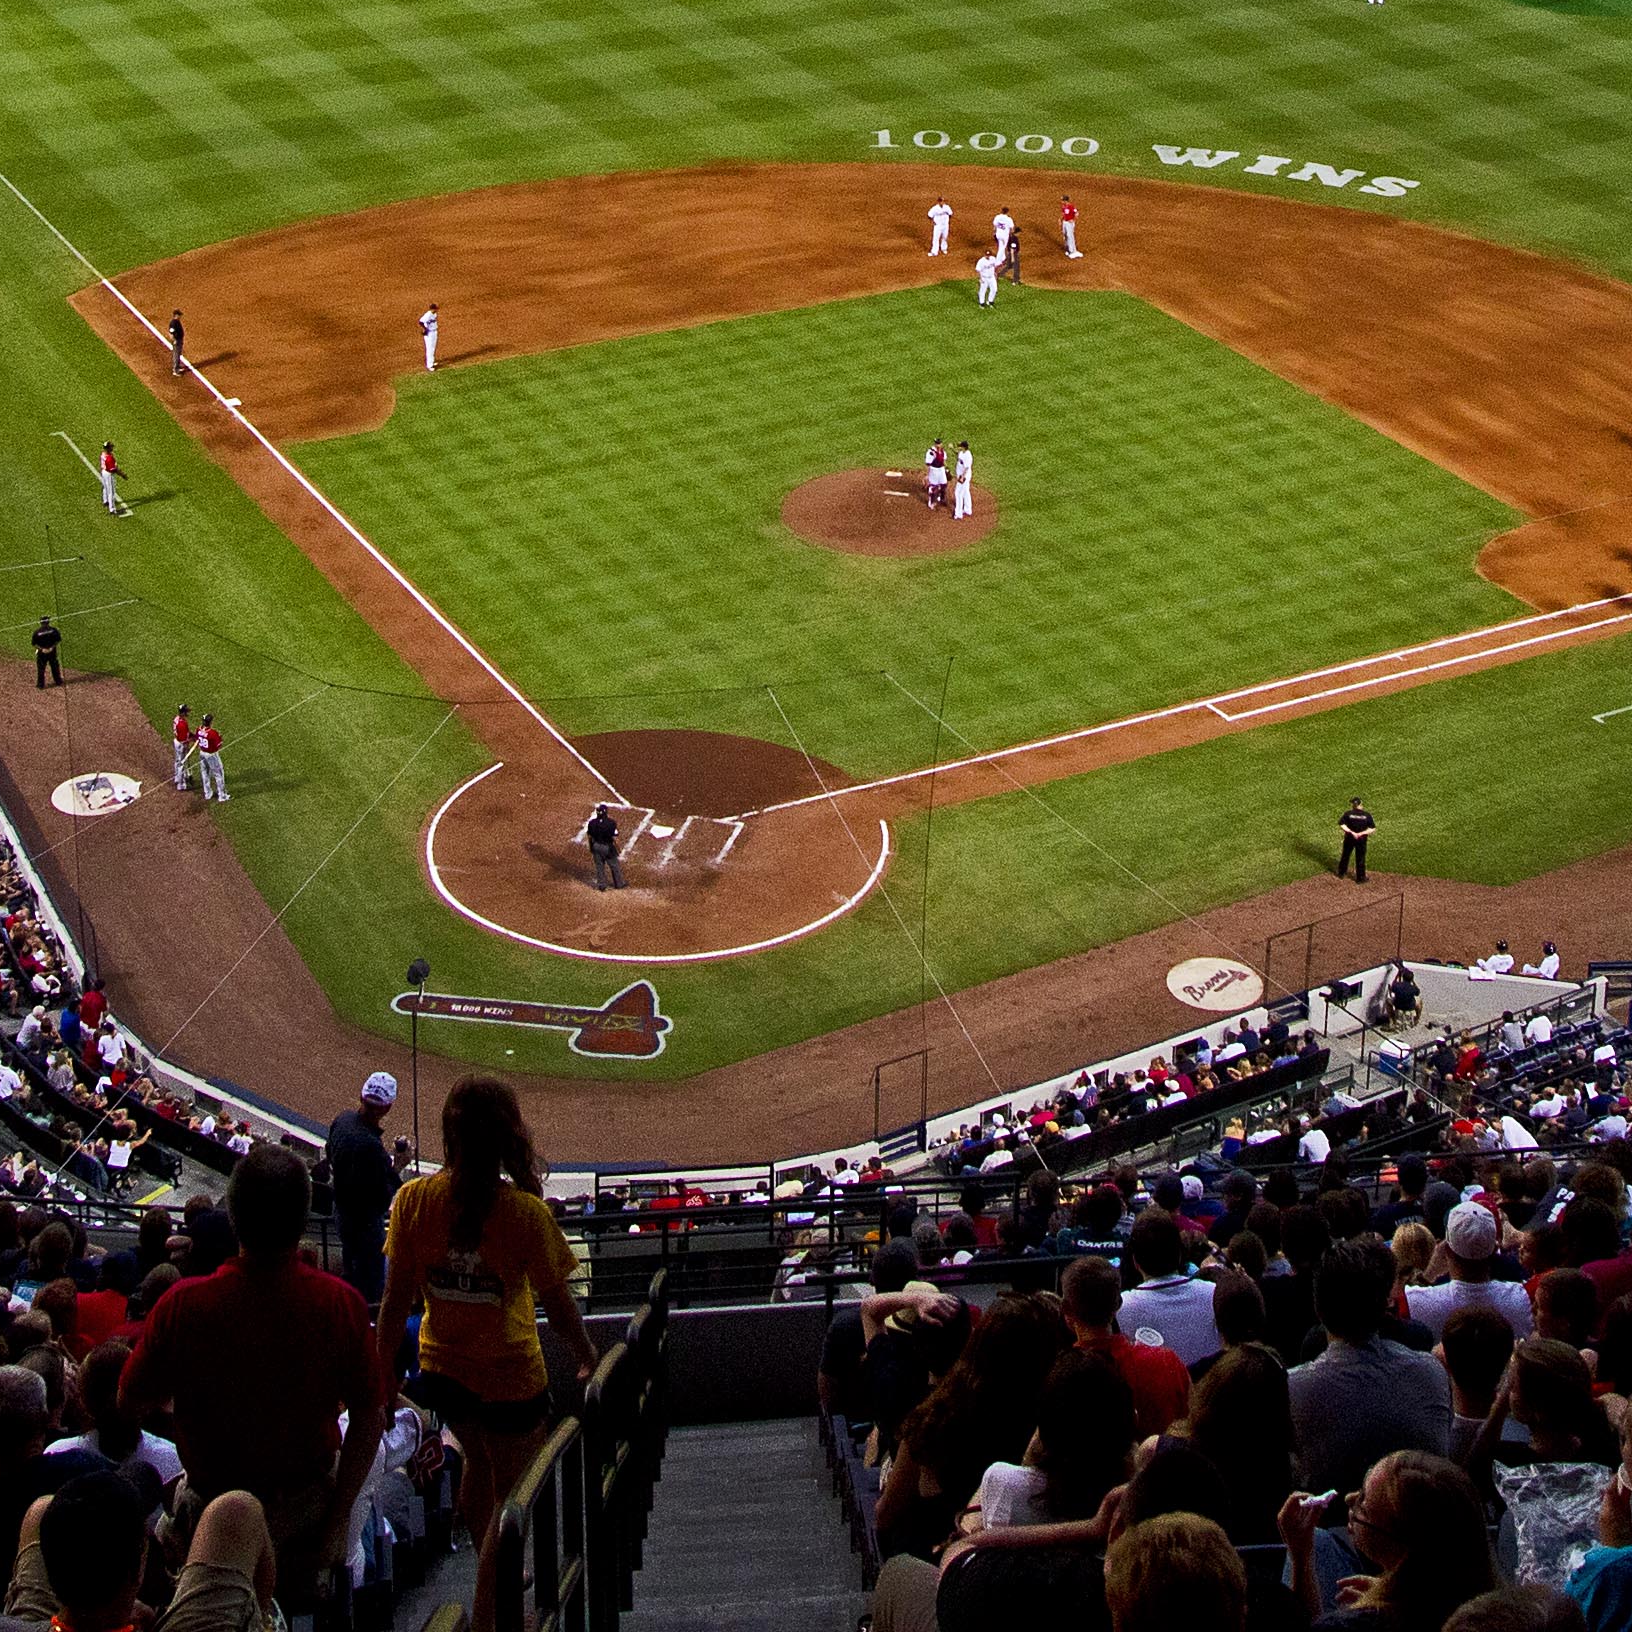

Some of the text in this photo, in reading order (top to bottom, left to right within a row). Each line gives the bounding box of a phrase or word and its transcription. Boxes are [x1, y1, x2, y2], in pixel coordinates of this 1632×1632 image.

[868, 128, 1421, 198] 10,000 WINS
[1183, 969, 1230, 1003] Braves
[1075, 1238, 1125, 1250] QANTAS
